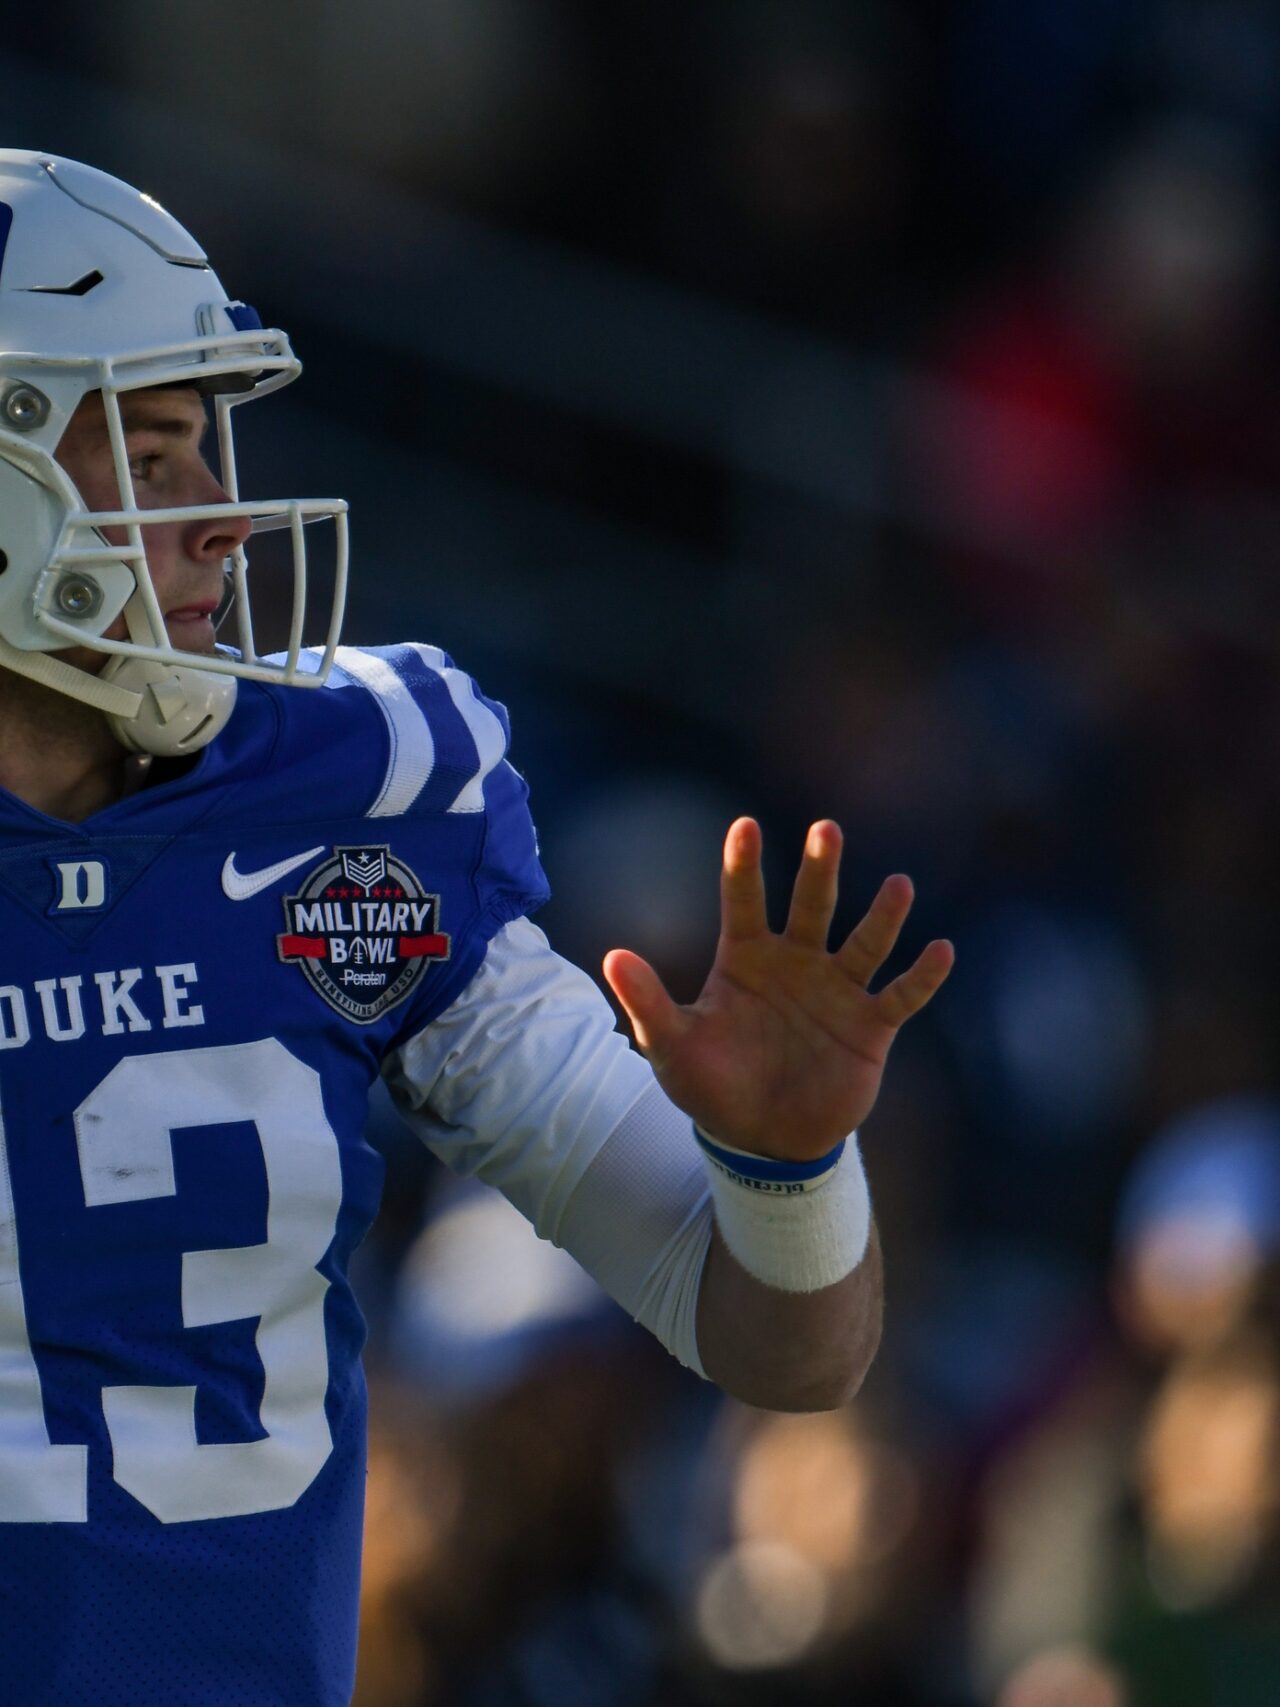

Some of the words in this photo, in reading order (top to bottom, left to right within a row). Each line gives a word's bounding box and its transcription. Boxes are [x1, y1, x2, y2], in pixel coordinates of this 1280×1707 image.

[56, 861, 105, 910] D
[293, 902, 432, 933] MILITARY
[328, 936, 397, 964] BOWL
[390, 968, 414, 994] USO
